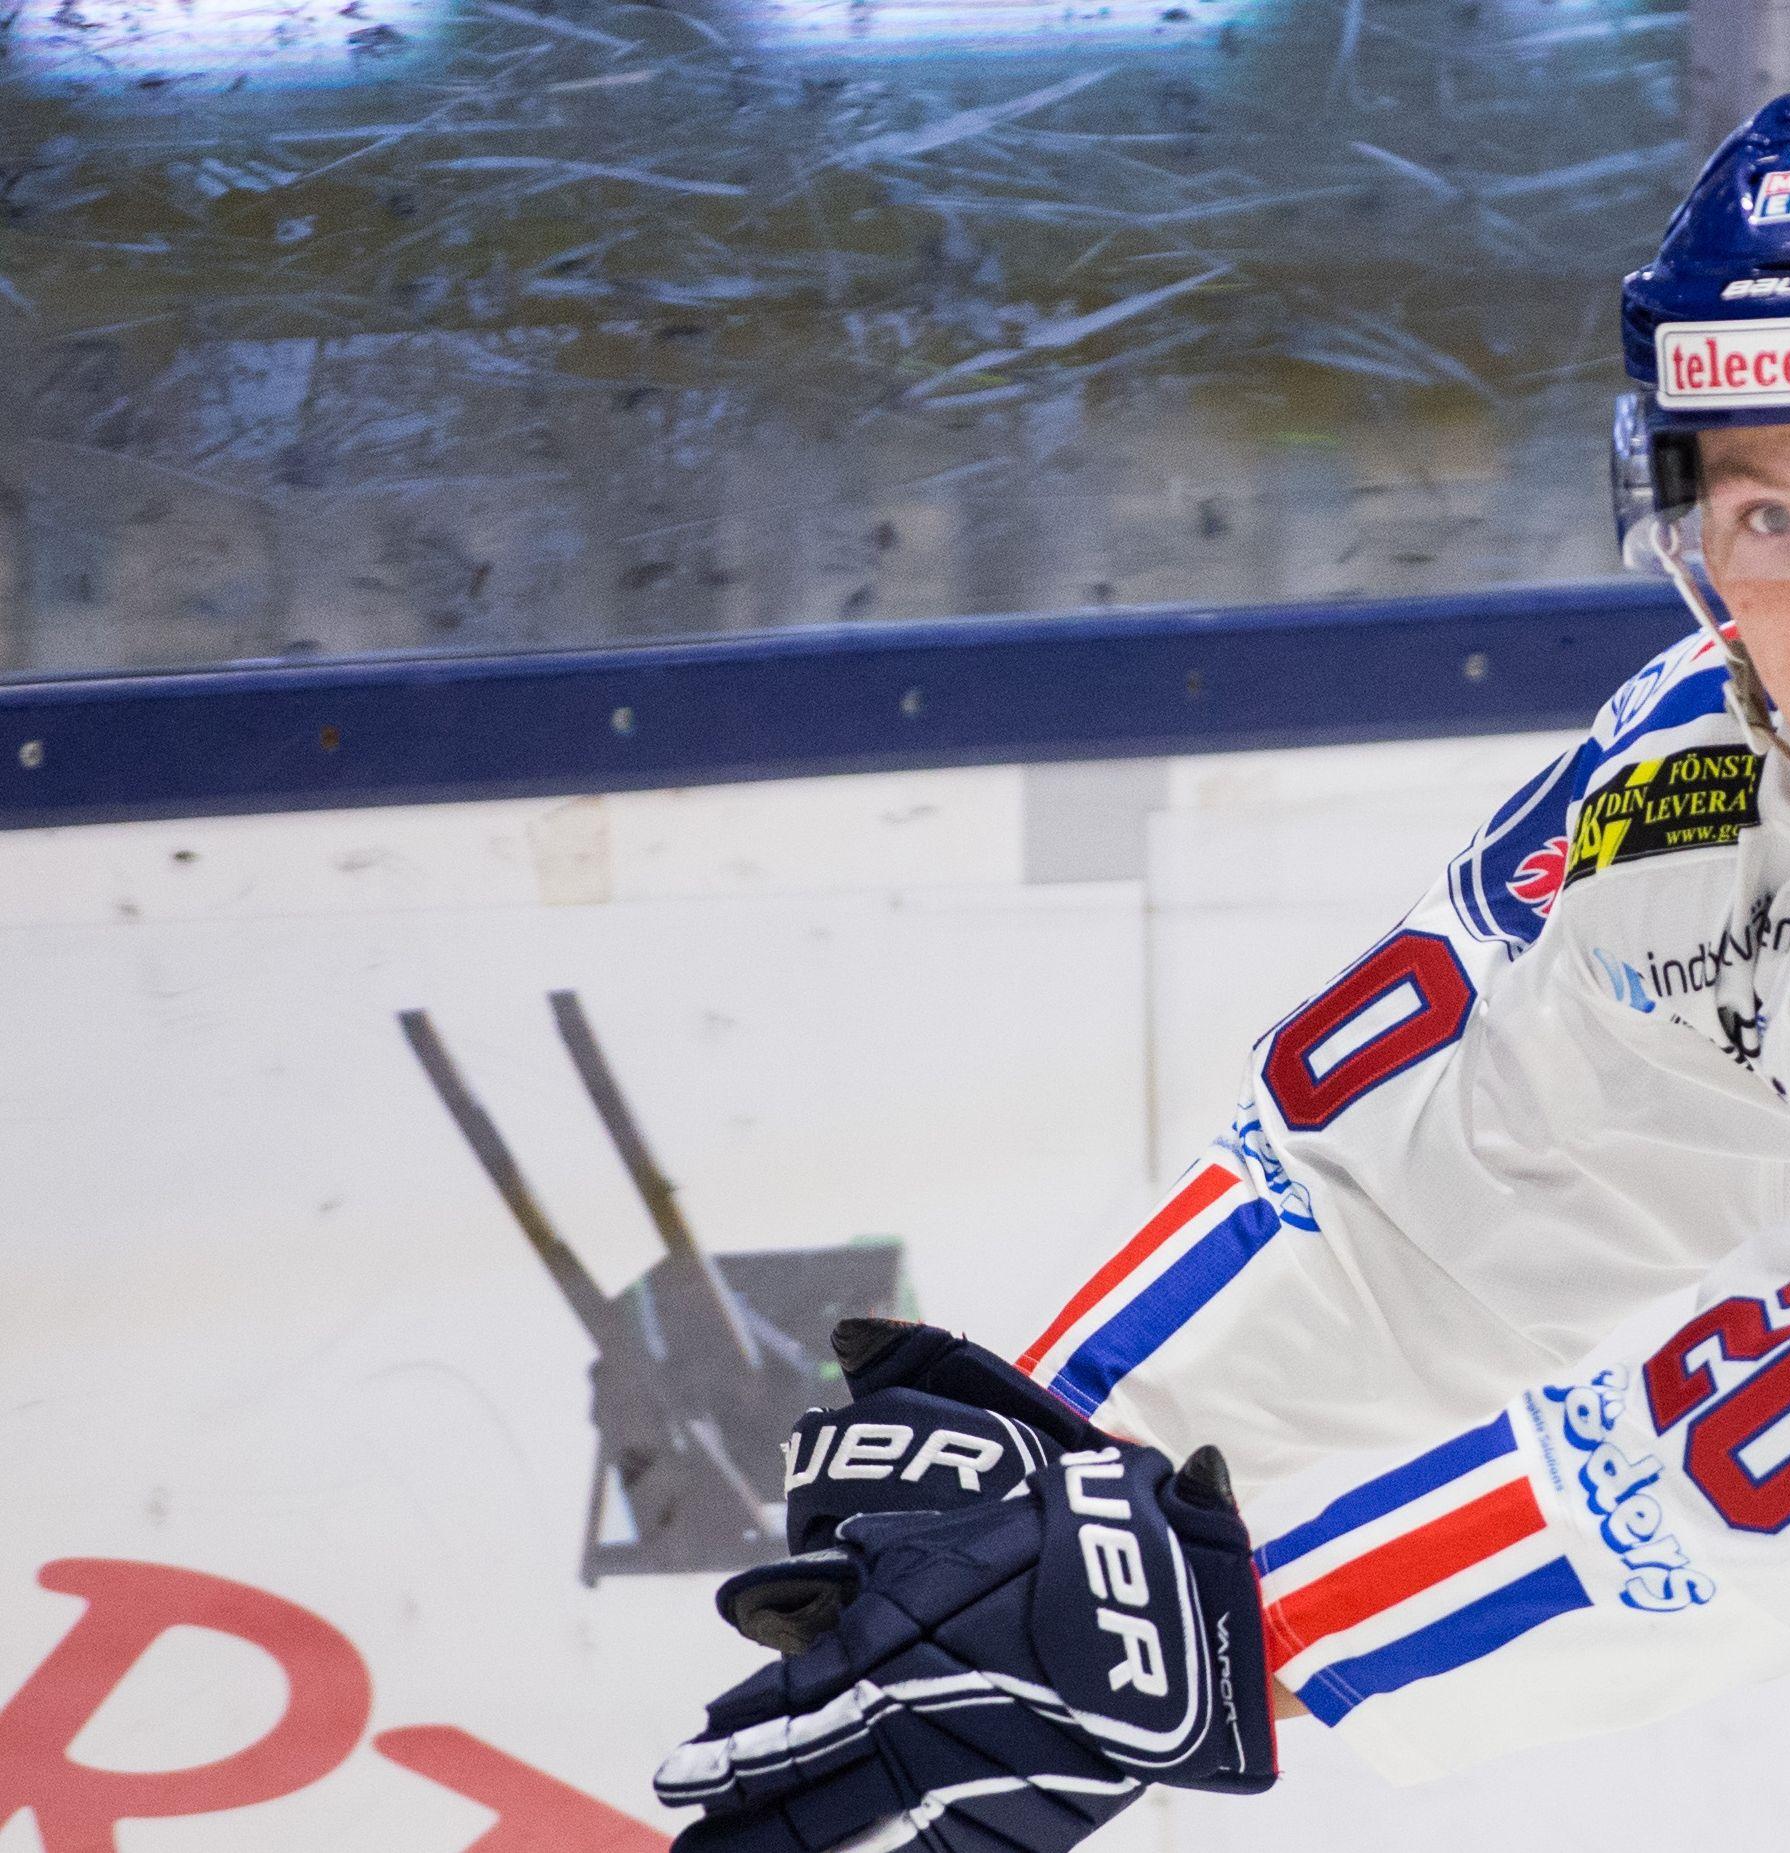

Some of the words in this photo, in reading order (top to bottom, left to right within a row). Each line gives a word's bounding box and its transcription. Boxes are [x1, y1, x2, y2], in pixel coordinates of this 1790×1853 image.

[1668, 753, 1757, 786] FÖNST
[1605, 786, 1649, 818] DIN
[1643, 788, 1754, 824] LEVERA
[780, 1423, 1005, 1500] UER
[1060, 1447, 1169, 1698] UER
